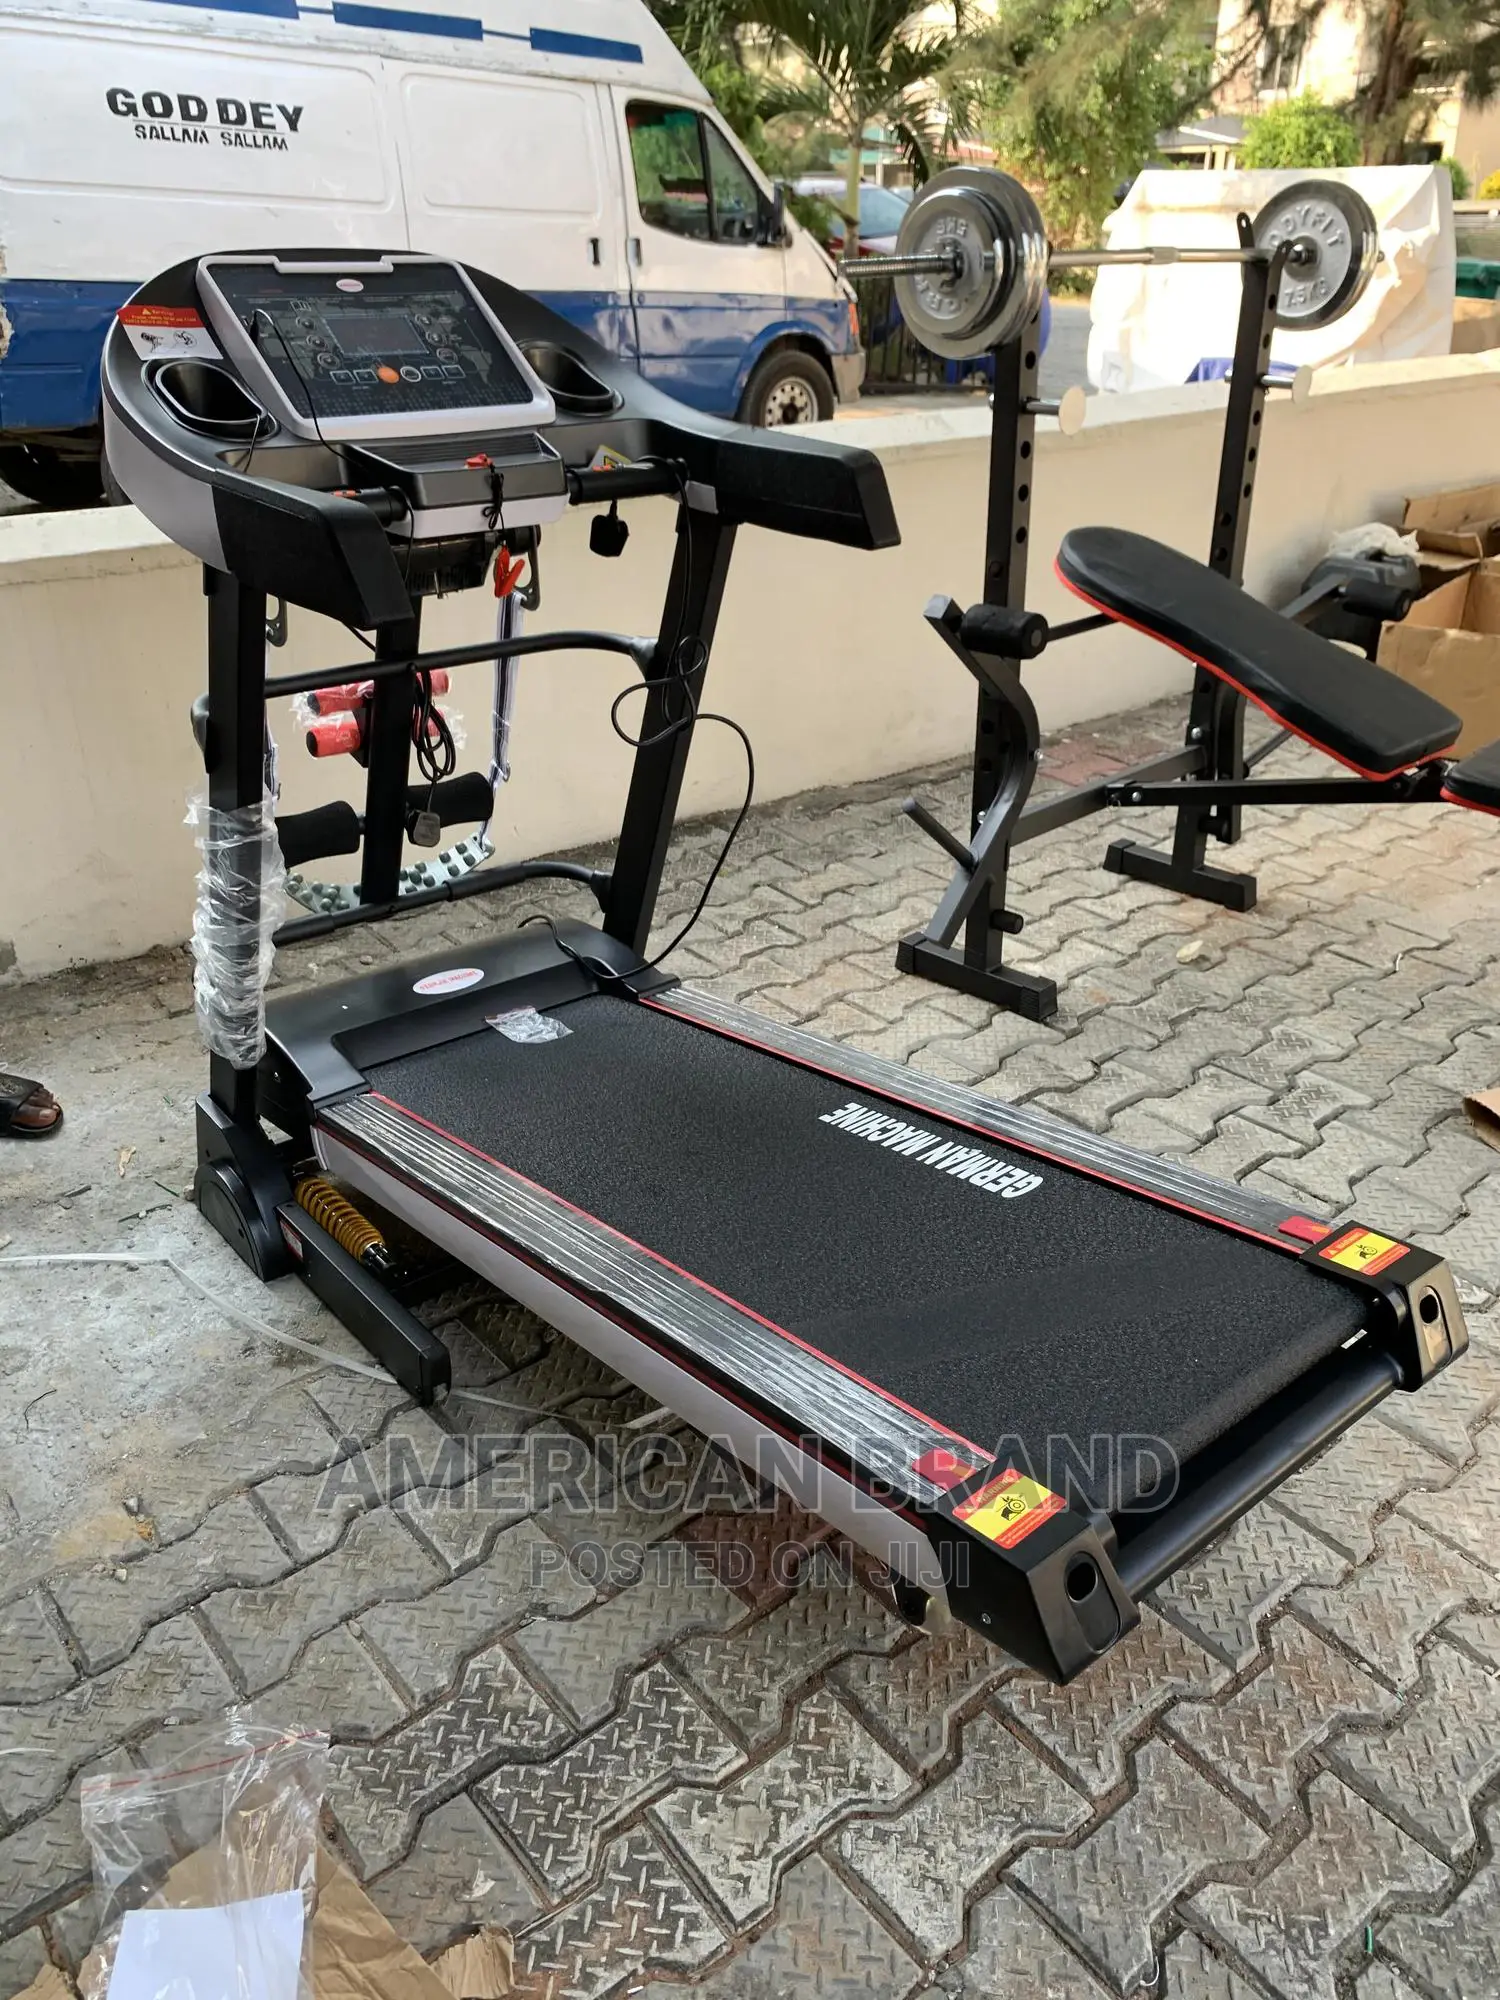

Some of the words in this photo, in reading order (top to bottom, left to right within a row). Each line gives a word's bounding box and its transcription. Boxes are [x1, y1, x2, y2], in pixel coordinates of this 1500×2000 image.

[220, 131, 289, 151] SALLAM
[818, 1102, 942, 1156] MACHINE
[916, 1141, 1044, 1198] GERMAN
